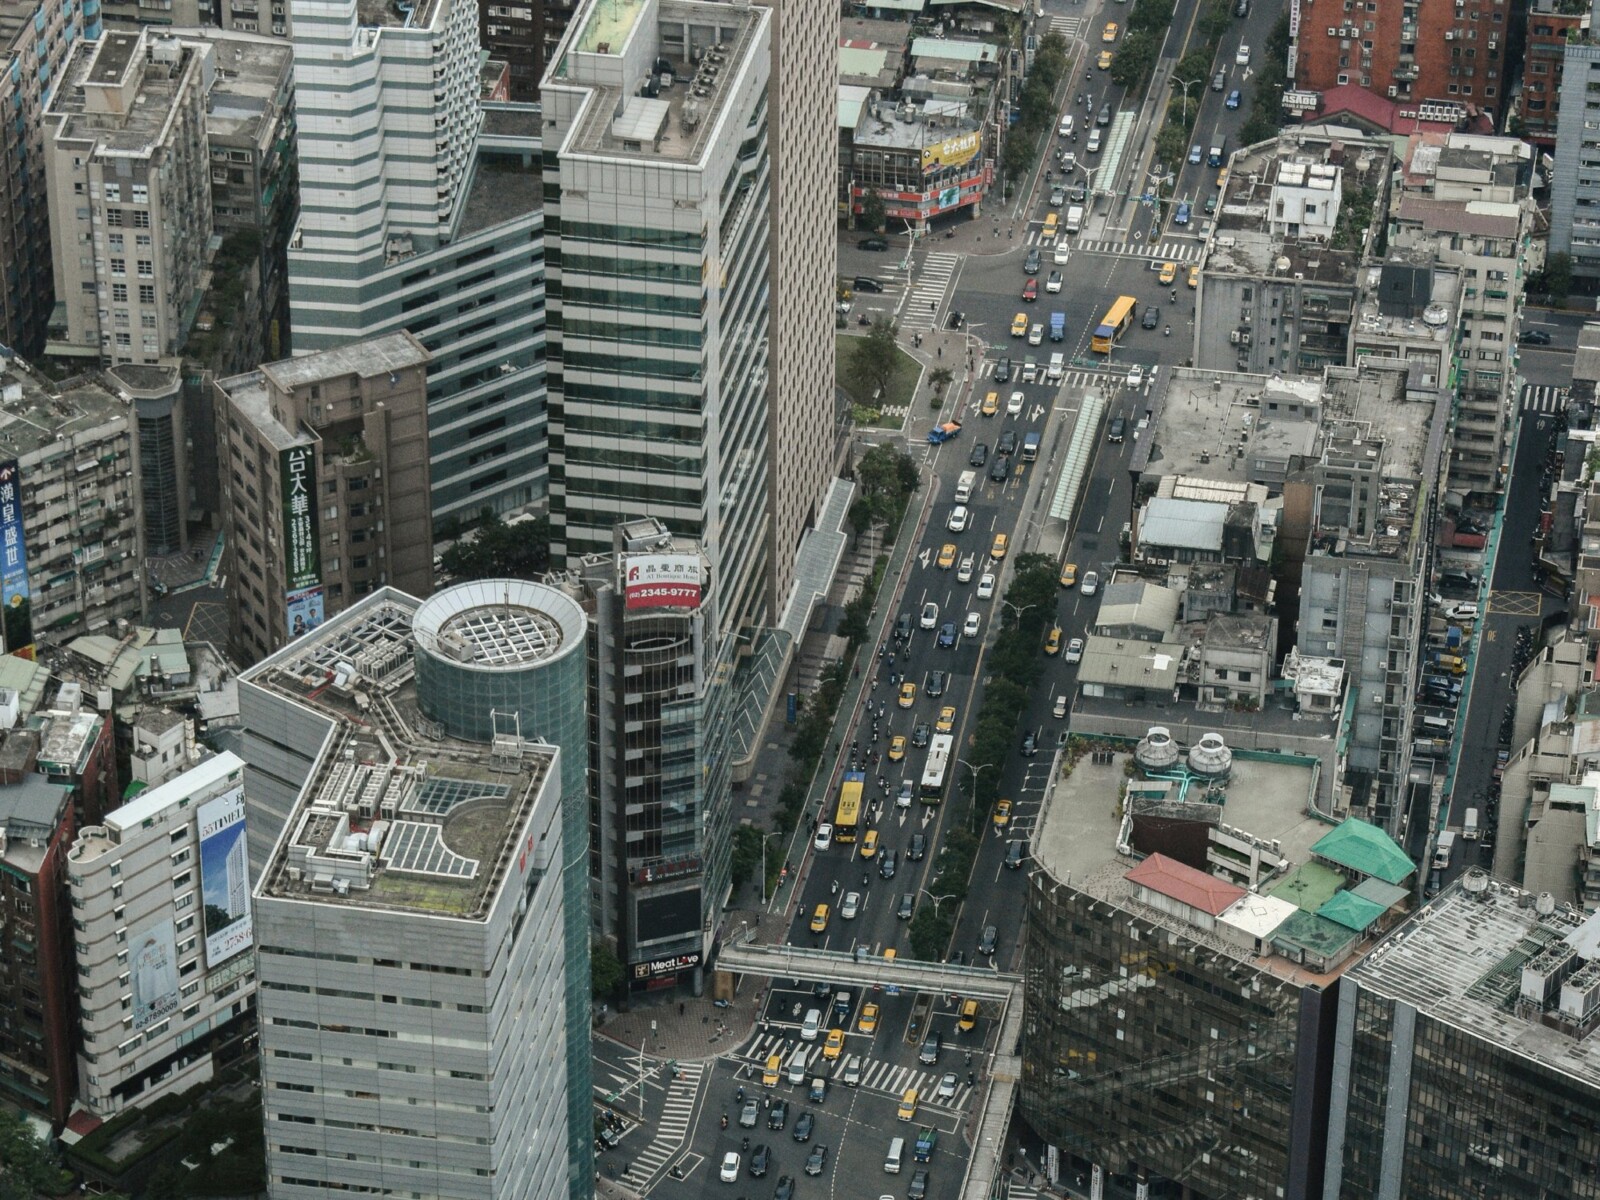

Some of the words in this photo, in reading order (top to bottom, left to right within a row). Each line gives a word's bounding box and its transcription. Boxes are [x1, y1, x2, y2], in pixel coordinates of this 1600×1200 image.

[0, 483, 19, 566] 漢皇盛世
[641, 588, 697, 598] 2345-9777
[651, 958, 675, 971] Meat
